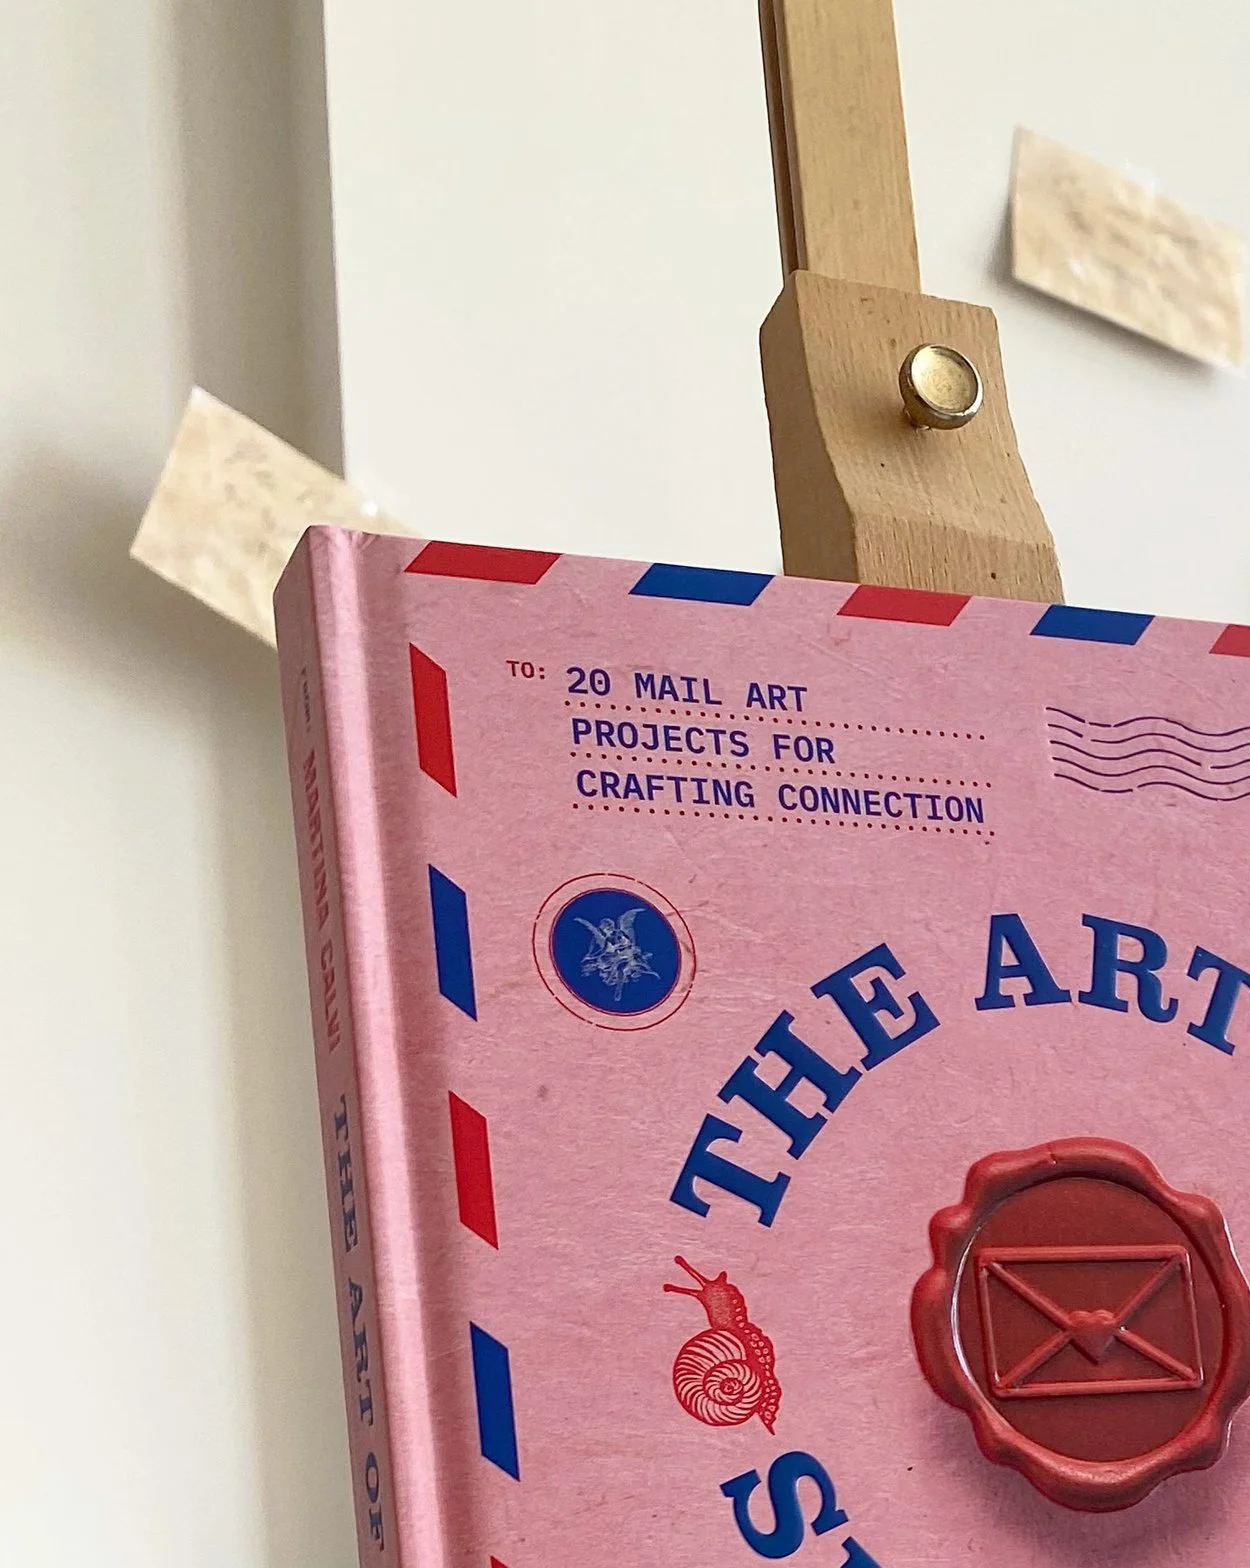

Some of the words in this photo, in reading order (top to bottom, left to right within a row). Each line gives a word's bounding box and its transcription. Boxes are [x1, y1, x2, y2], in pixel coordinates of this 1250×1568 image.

[506, 660, 546, 681] TO:
[565, 666, 611, 696] 20
[635, 672, 722, 706] MAIL
[746, 682, 808, 713] ART
[571, 717, 750, 758] PROJECTS
[773, 734, 836, 764] FOR
[576, 769, 756, 809] CRAFTING
[778, 783, 985, 824] CONNECTION
[302, 748, 331, 932] MARTINA
[320, 939, 342, 1055] CALVI
[669, 942, 941, 1229] THE
[334, 1093, 359, 1253] THE
[348, 1276, 374, 1427] ART
[364, 1451, 386, 1553] OF
